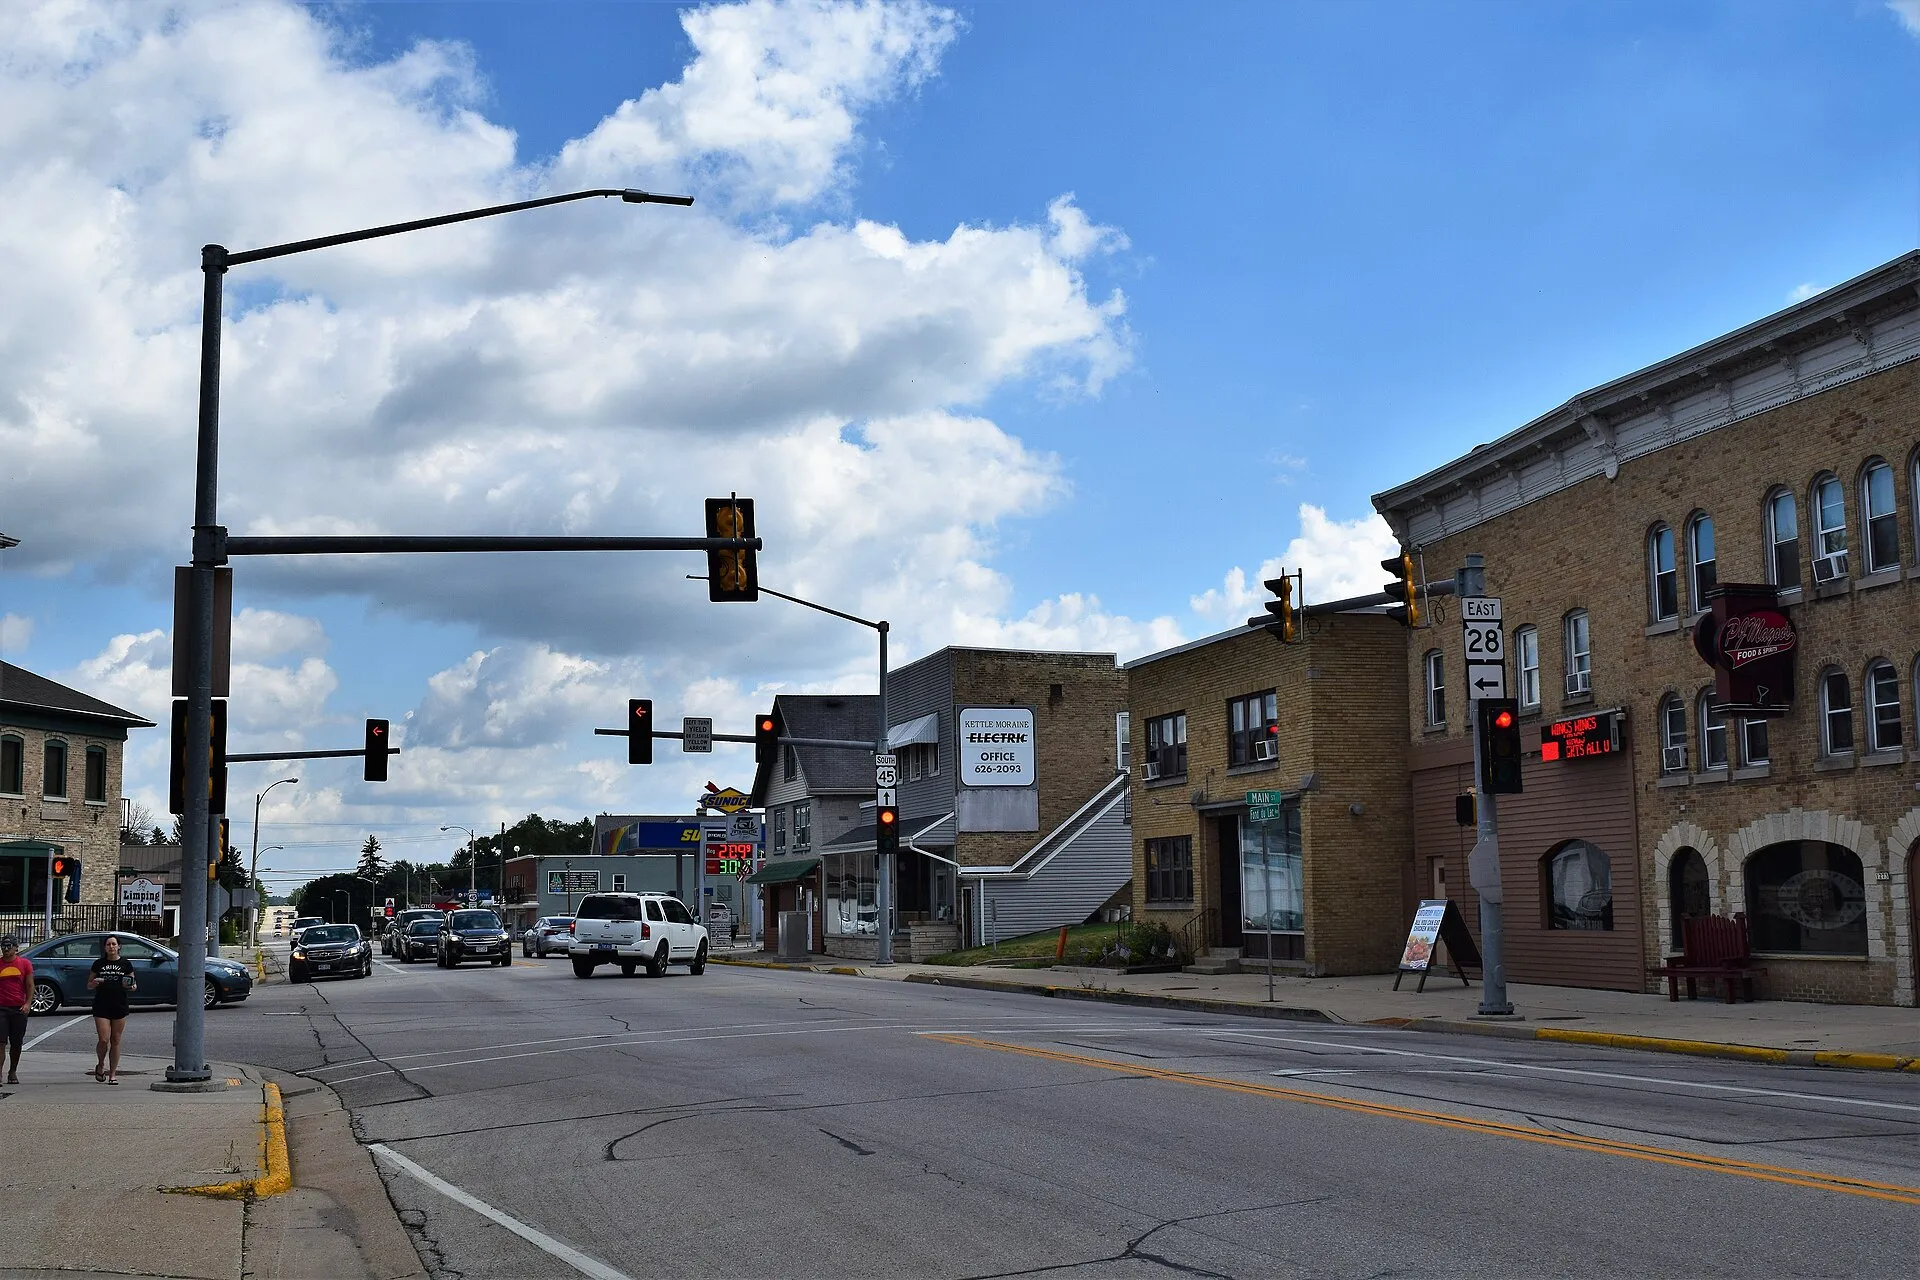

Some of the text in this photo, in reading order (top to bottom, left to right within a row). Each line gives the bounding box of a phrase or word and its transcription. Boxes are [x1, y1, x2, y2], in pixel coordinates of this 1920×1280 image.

[1467, 601, 1496, 616] EAST
[1467, 628, 1500, 653] 28
[1737, 649, 1757, 660] FOOD
[1757, 648, 1762, 656] &
[964, 720, 1030, 728] KETTLE MORAINE
[1551, 717, 1597, 736] WINGS WINGS
[968, 732, 1028, 743] ELECTRIC
[877, 756, 896, 764] SOUTH
[980, 752, 1015, 761] OFFICE
[974, 764, 1022, 773] 626-2093
[878, 770, 895, 783] 45
[1251, 792, 1270, 803] MAIN
[123, 890, 160, 902] Limping
